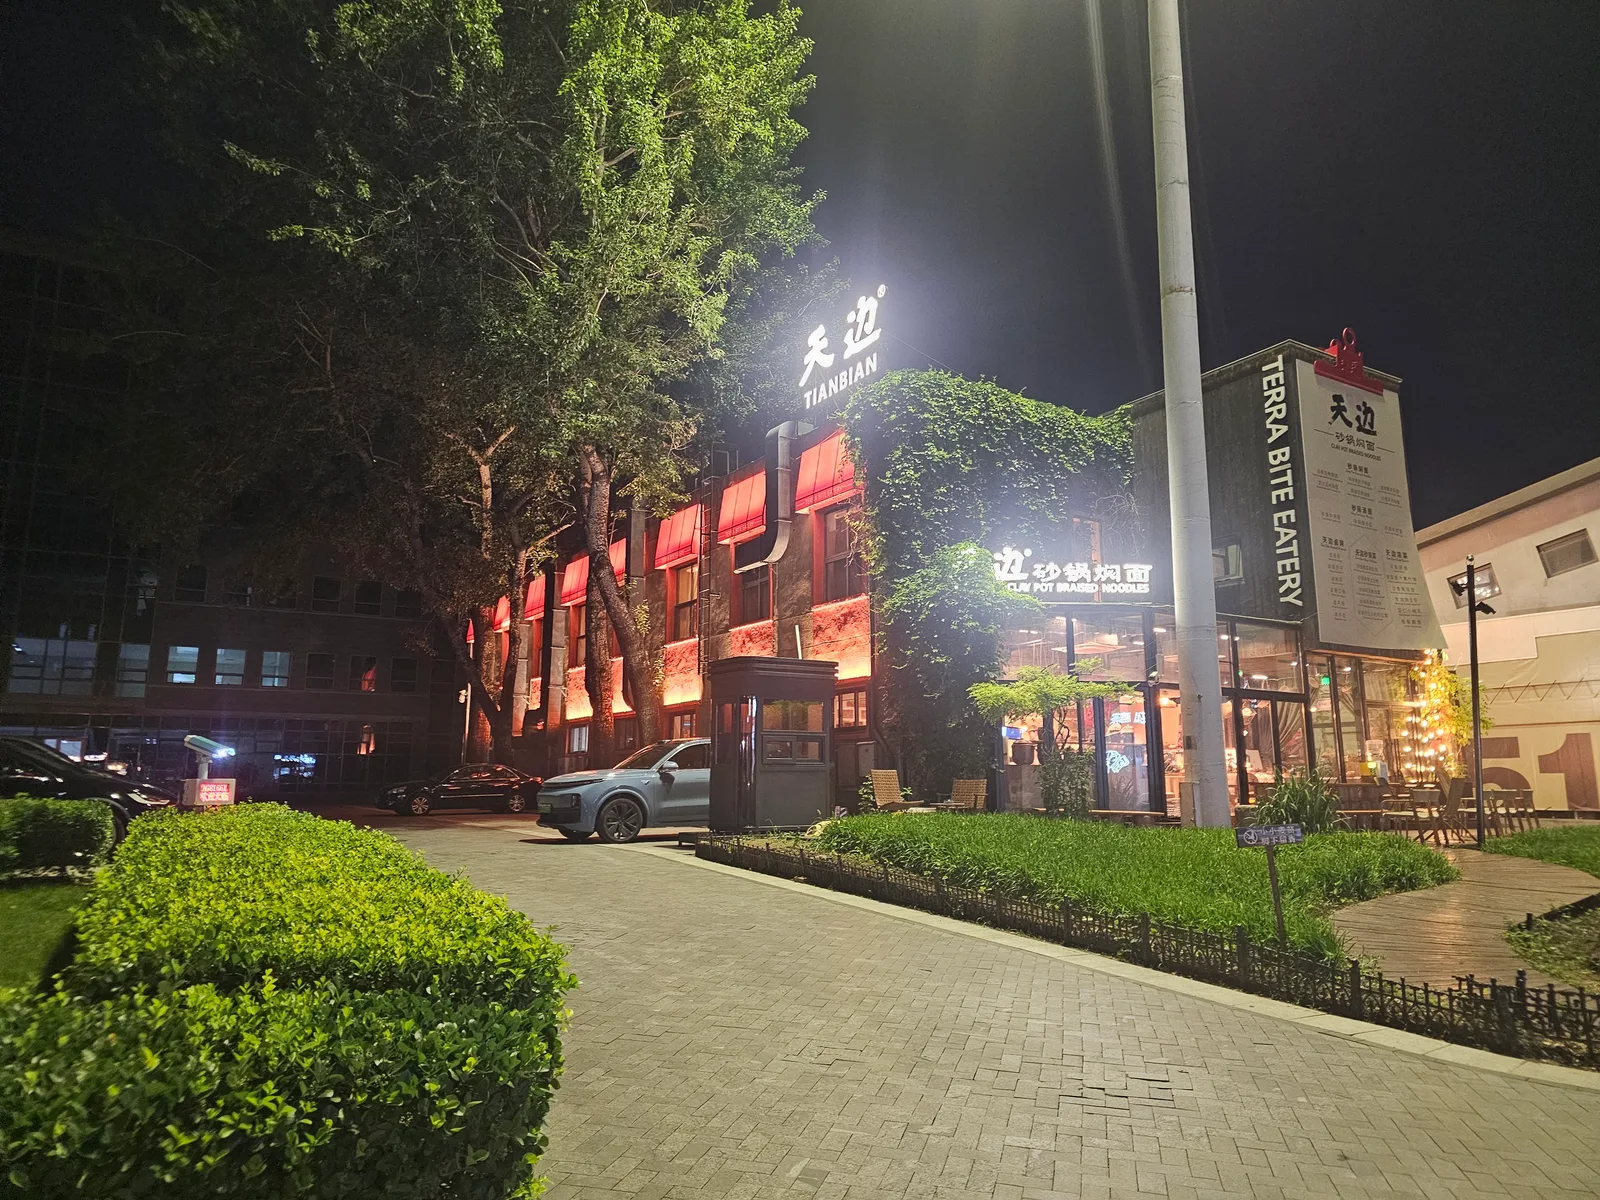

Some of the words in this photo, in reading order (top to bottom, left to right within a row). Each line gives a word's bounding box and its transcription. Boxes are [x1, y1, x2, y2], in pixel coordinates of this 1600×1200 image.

[799, 295, 881, 388] 天边
[804, 352, 877, 410] TIANBIAN
[1261, 354, 1289, 444] TERRA
[1328, 393, 1378, 436] 天边
[1334, 431, 1376, 452] 砂锅焖面
[1268, 446, 1294, 505] BITE
[1032, 561, 1153, 583] 砂锅焖面
[1273, 509, 1303, 607] EATERY
[1033, 582, 1053, 592] POT
[1056, 582, 1099, 593] BRAISED
[1102, 582, 1150, 593] NOODLES
